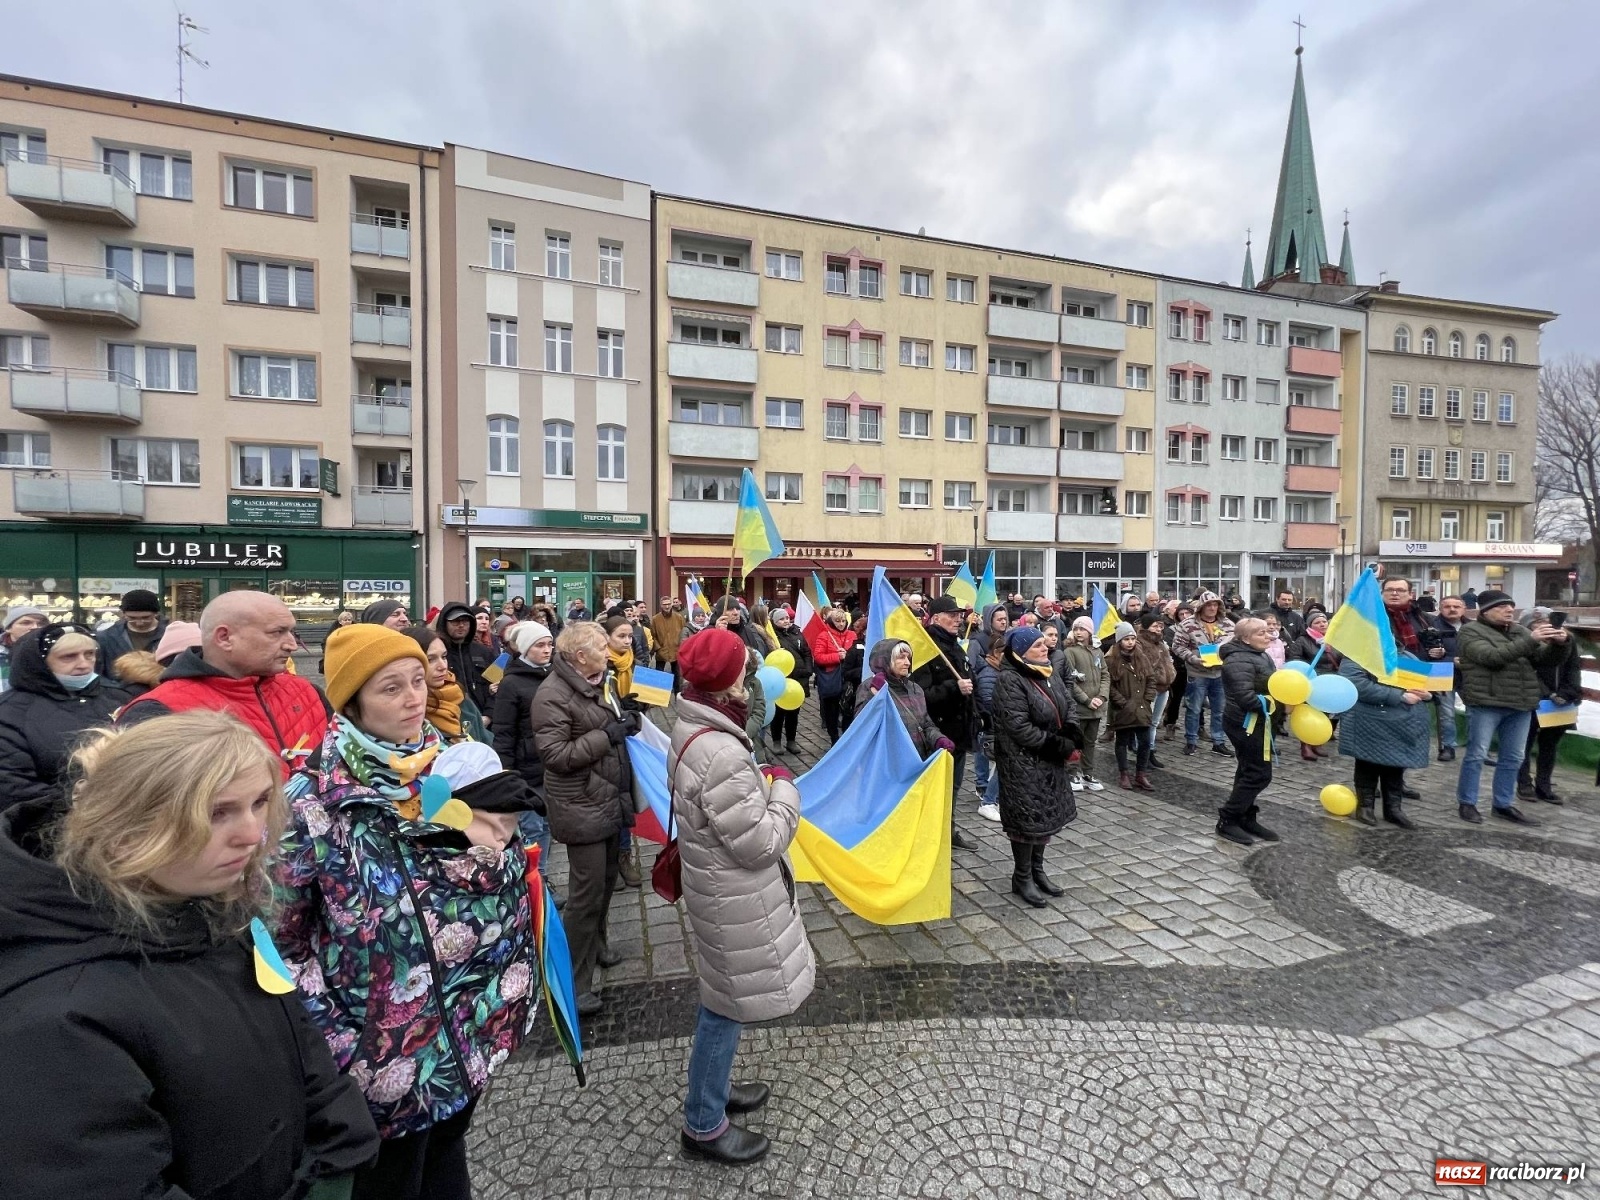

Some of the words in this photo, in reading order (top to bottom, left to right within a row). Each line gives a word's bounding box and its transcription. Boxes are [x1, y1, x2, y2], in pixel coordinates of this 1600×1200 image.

[136, 542, 283, 558] JUBILER
[1485, 544, 1535, 553] ROSSMANN
[1088, 557, 1116, 569] empik
[347, 581, 404, 591] CASIO
